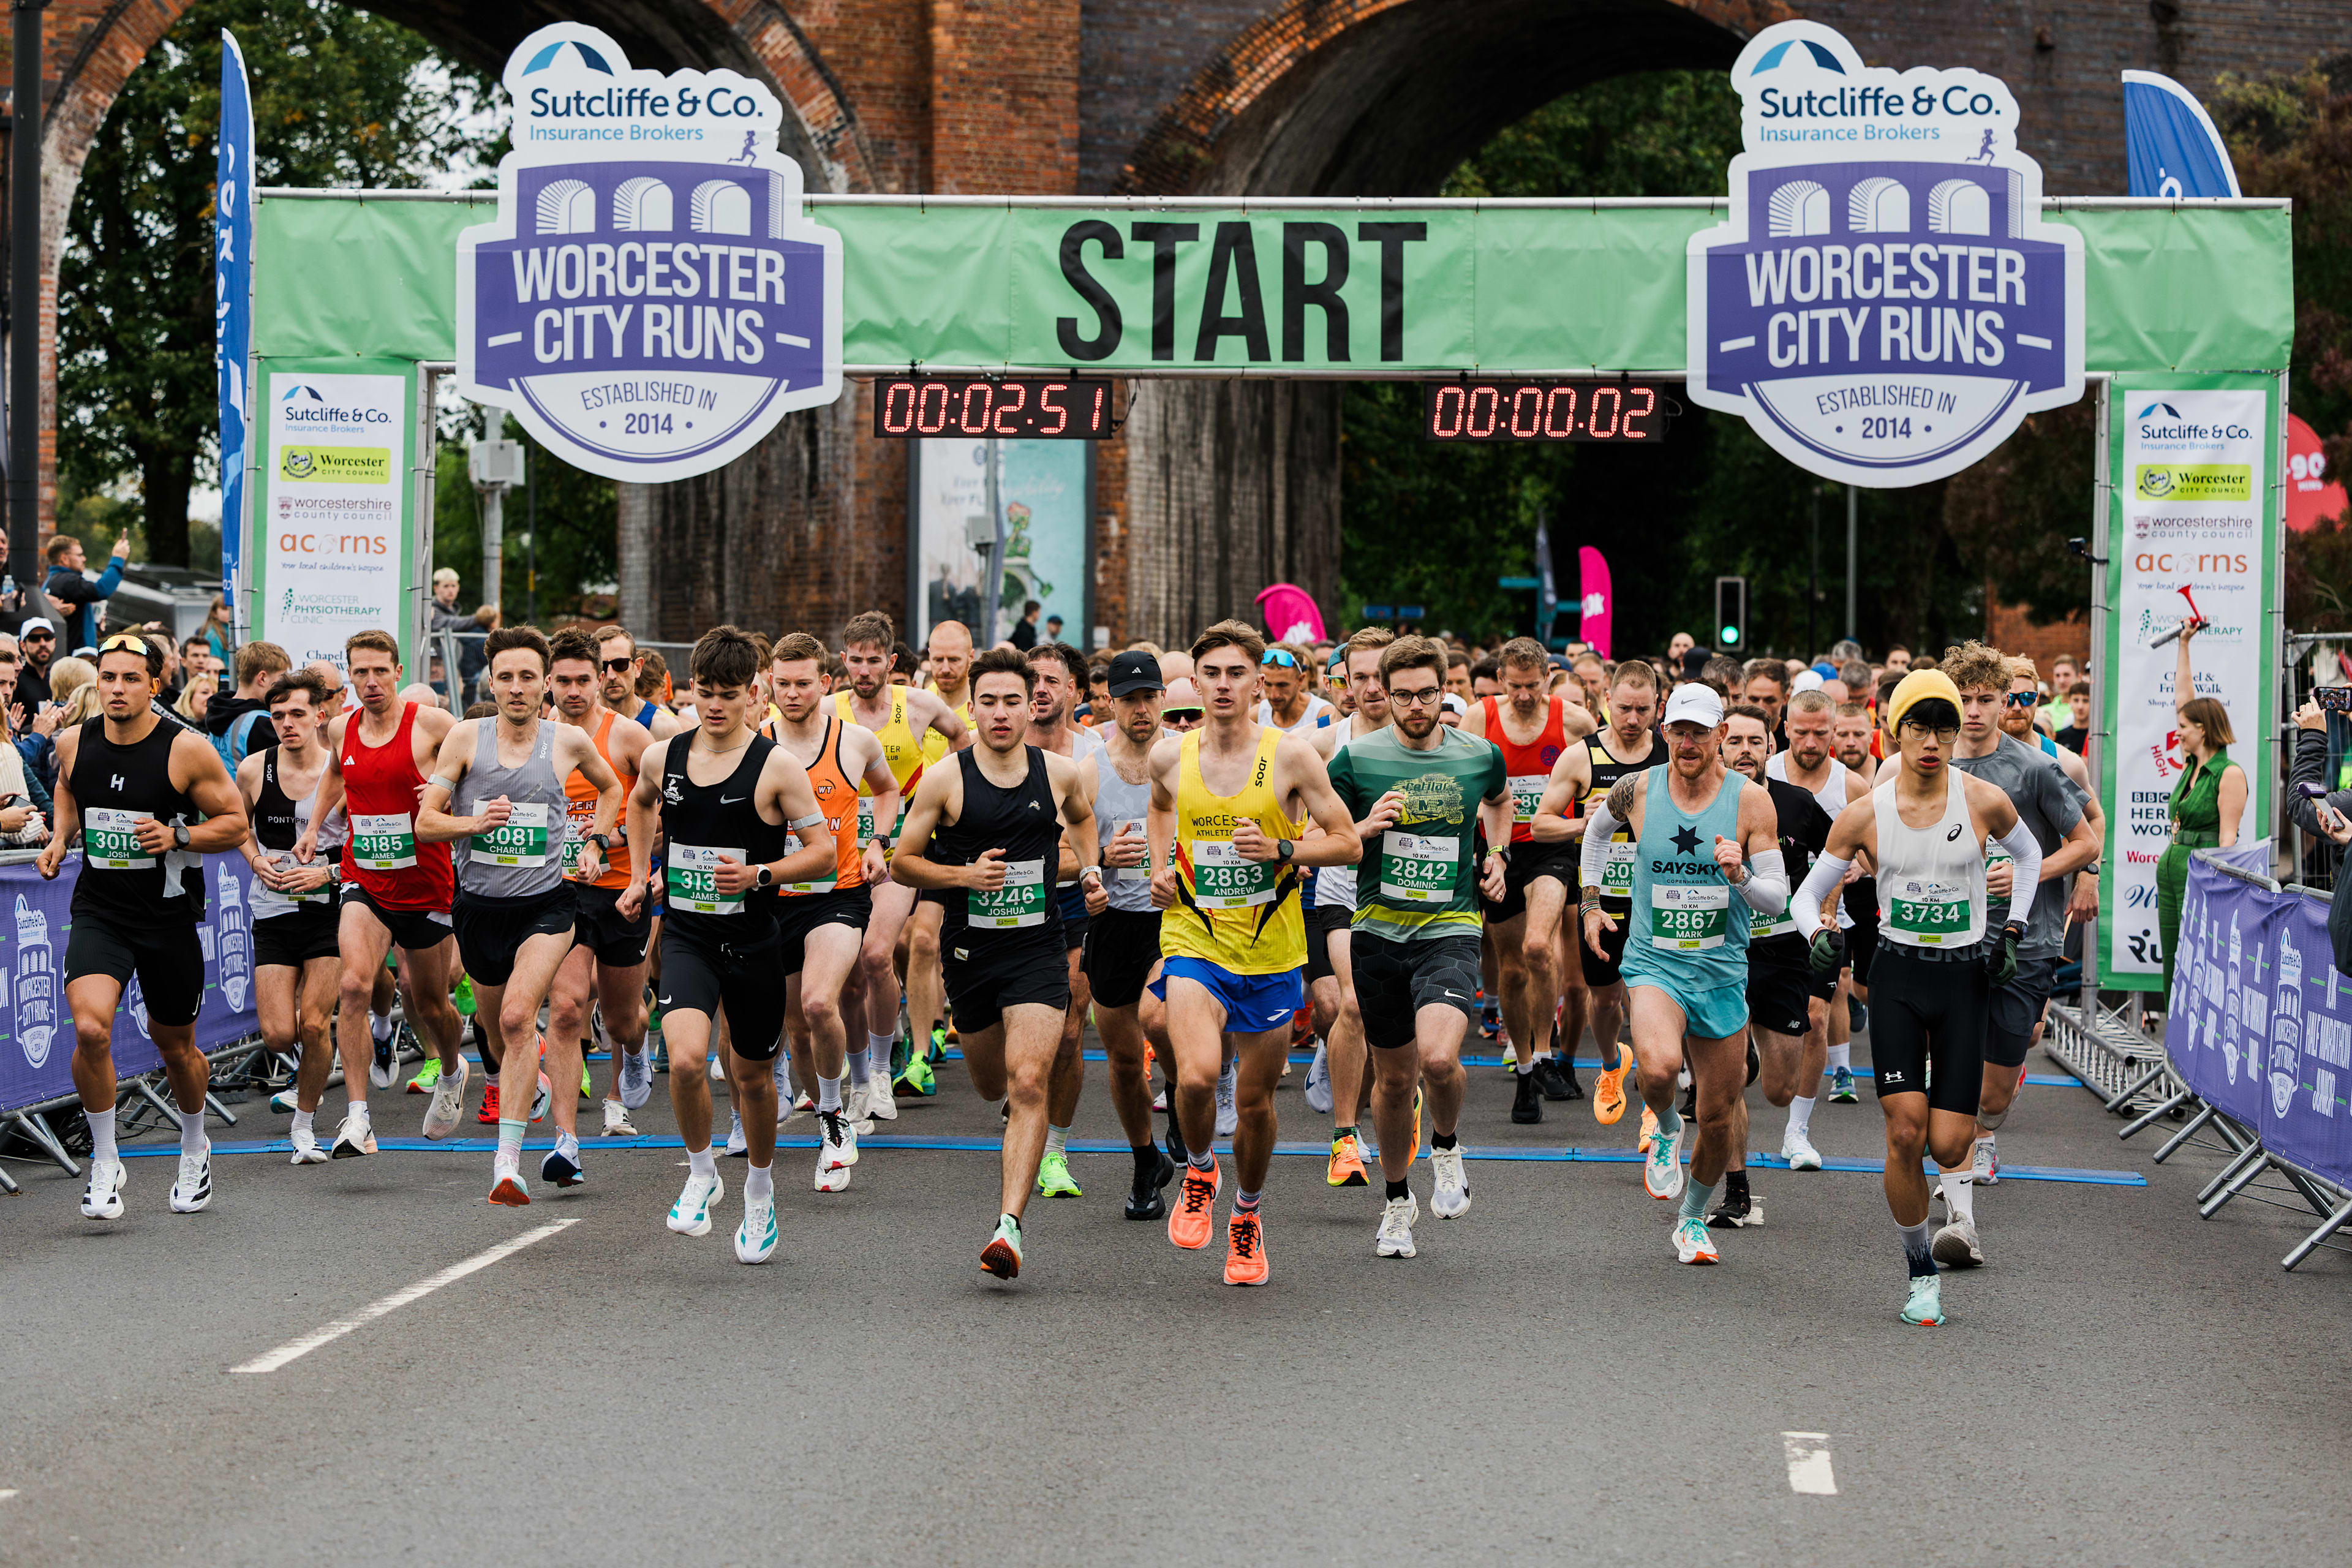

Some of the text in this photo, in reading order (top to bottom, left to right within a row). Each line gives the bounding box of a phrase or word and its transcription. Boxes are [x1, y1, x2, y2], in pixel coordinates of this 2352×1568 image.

[530, 88, 763, 117] Sutcliffe & Co.
[1760, 86, 2000, 118] Sutcliffe & Co.
[530, 124, 703, 141] Insurance Brokers
[1760, 124, 1940, 141] Insurance Brokers
[512, 243, 785, 304] WORCESTER
[1745, 243, 2026, 307] WORCESTER
[1057, 220, 1427, 362] START
[534, 304, 764, 364] CITY RUNS
[1768, 307, 2004, 368] CITY RUNS
[581, 381, 718, 411] ESTABLISHED IN
[1817, 385, 1956, 415] ESTABLISHED IN
[286, 407, 391, 423] Sutcliffe & Co.
[1433, 387, 1654, 438] 00:00.02
[331, 424, 364, 433] Brokers
[625, 413, 673, 434] 2014
[1862, 418, 1911, 439] 2014
[2141, 425, 2252, 439] Sutcliffe & Co.
[320, 455, 384, 467] Worcester
[2179, 473, 2245, 483] Worcester
[295, 498, 391, 510] worcestershire
[294, 511, 339, 521] county
[2152, 516, 2252, 528] worcestershire
[2151, 530, 2196, 539] county
[358, 565, 383, 574] hospice
[2218, 584, 2244, 594] hospice
[299, 595, 359, 604] WORCESTER
[291, 615, 323, 624] CLINIC
[307, 650, 342, 661] Chapel
[2205, 673, 2215, 682] &
[2195, 684, 2222, 693] Walk
[540, 741, 548, 760] soar
[2151, 745, 2169, 777] HIGH
[1255, 756, 1267, 788] soar
[2132, 791, 2171, 803] BBC
[268, 816, 309, 825] PONTYPRI
[1192, 815, 1261, 826] WORCESR
[96, 832, 141, 851] 3016
[361, 836, 402, 851] 3185
[483, 827, 533, 846] 3081
[489, 846, 526, 854] CHARLIE
[1204, 865, 1263, 887] 2863
[1391, 858, 1447, 880] 2842
[1651, 861, 1720, 875] SAYSKY
[681, 871, 715, 892] 313
[1397, 878, 1438, 889] DOMINIC
[690, 892, 720, 901] JAMES
[978, 886, 1035, 907] 3246
[1213, 886, 1255, 895] ANDREW
[987, 907, 1025, 915] JOSHUA
[1901, 903, 1960, 924] 3734
[1662, 911, 1717, 929] 2867
[1749, 918, 1776, 927] ATHAN
[20, 976, 51, 1003] WORCESTER
[23, 1000, 50, 1027] CITY RUNS
[2305, 1010, 2351, 1069] HALF MARATHON
